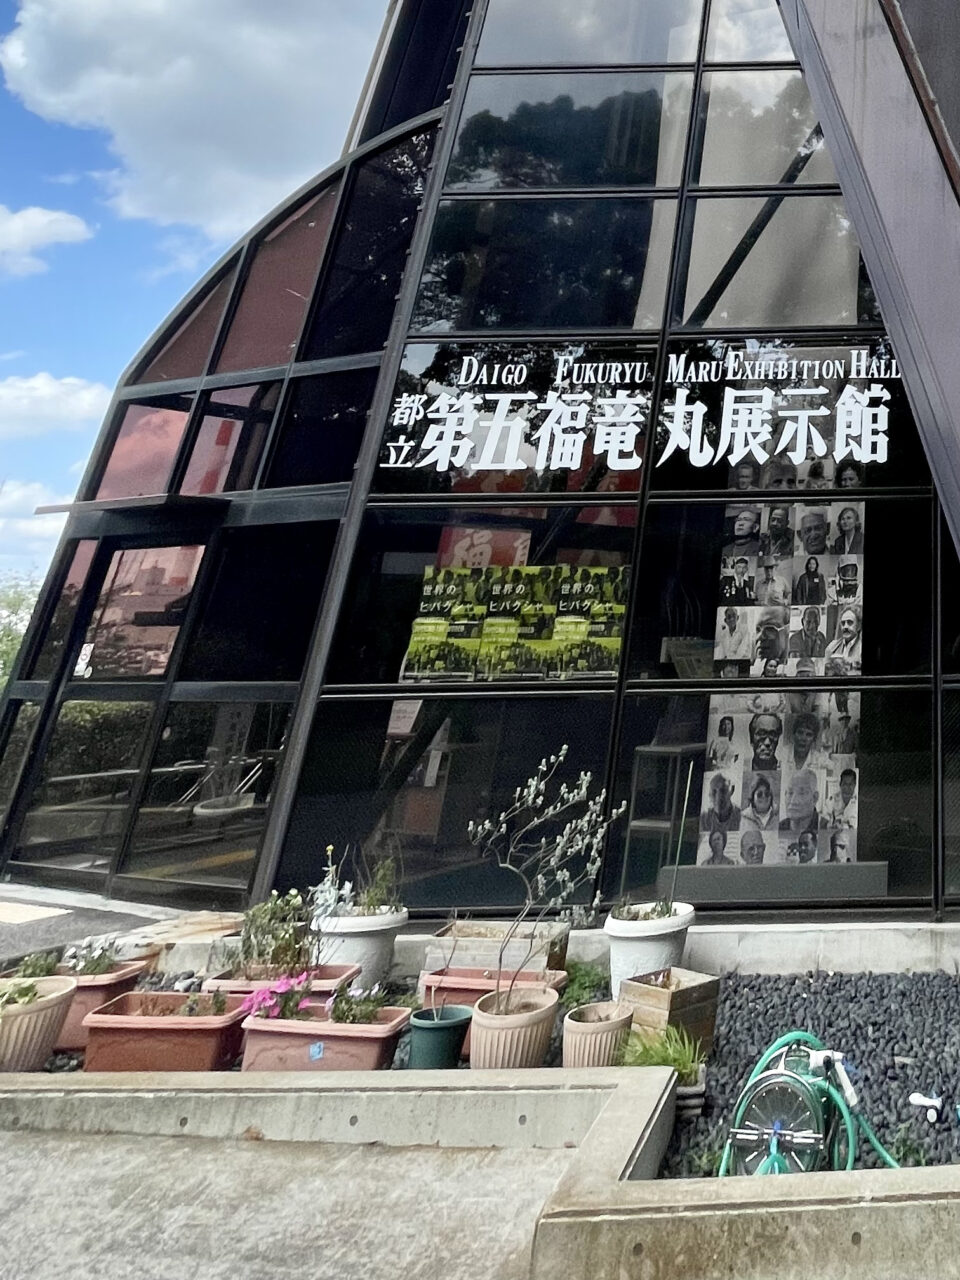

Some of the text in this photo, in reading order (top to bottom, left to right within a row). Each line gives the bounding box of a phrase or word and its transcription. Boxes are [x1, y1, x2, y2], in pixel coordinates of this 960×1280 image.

[414, 384, 892, 472] 第五福竜丸展示館
[423, 584, 457, 596] 世界の
[492, 583, 526, 595] 世界の
[561, 583, 595, 594] 世界の
